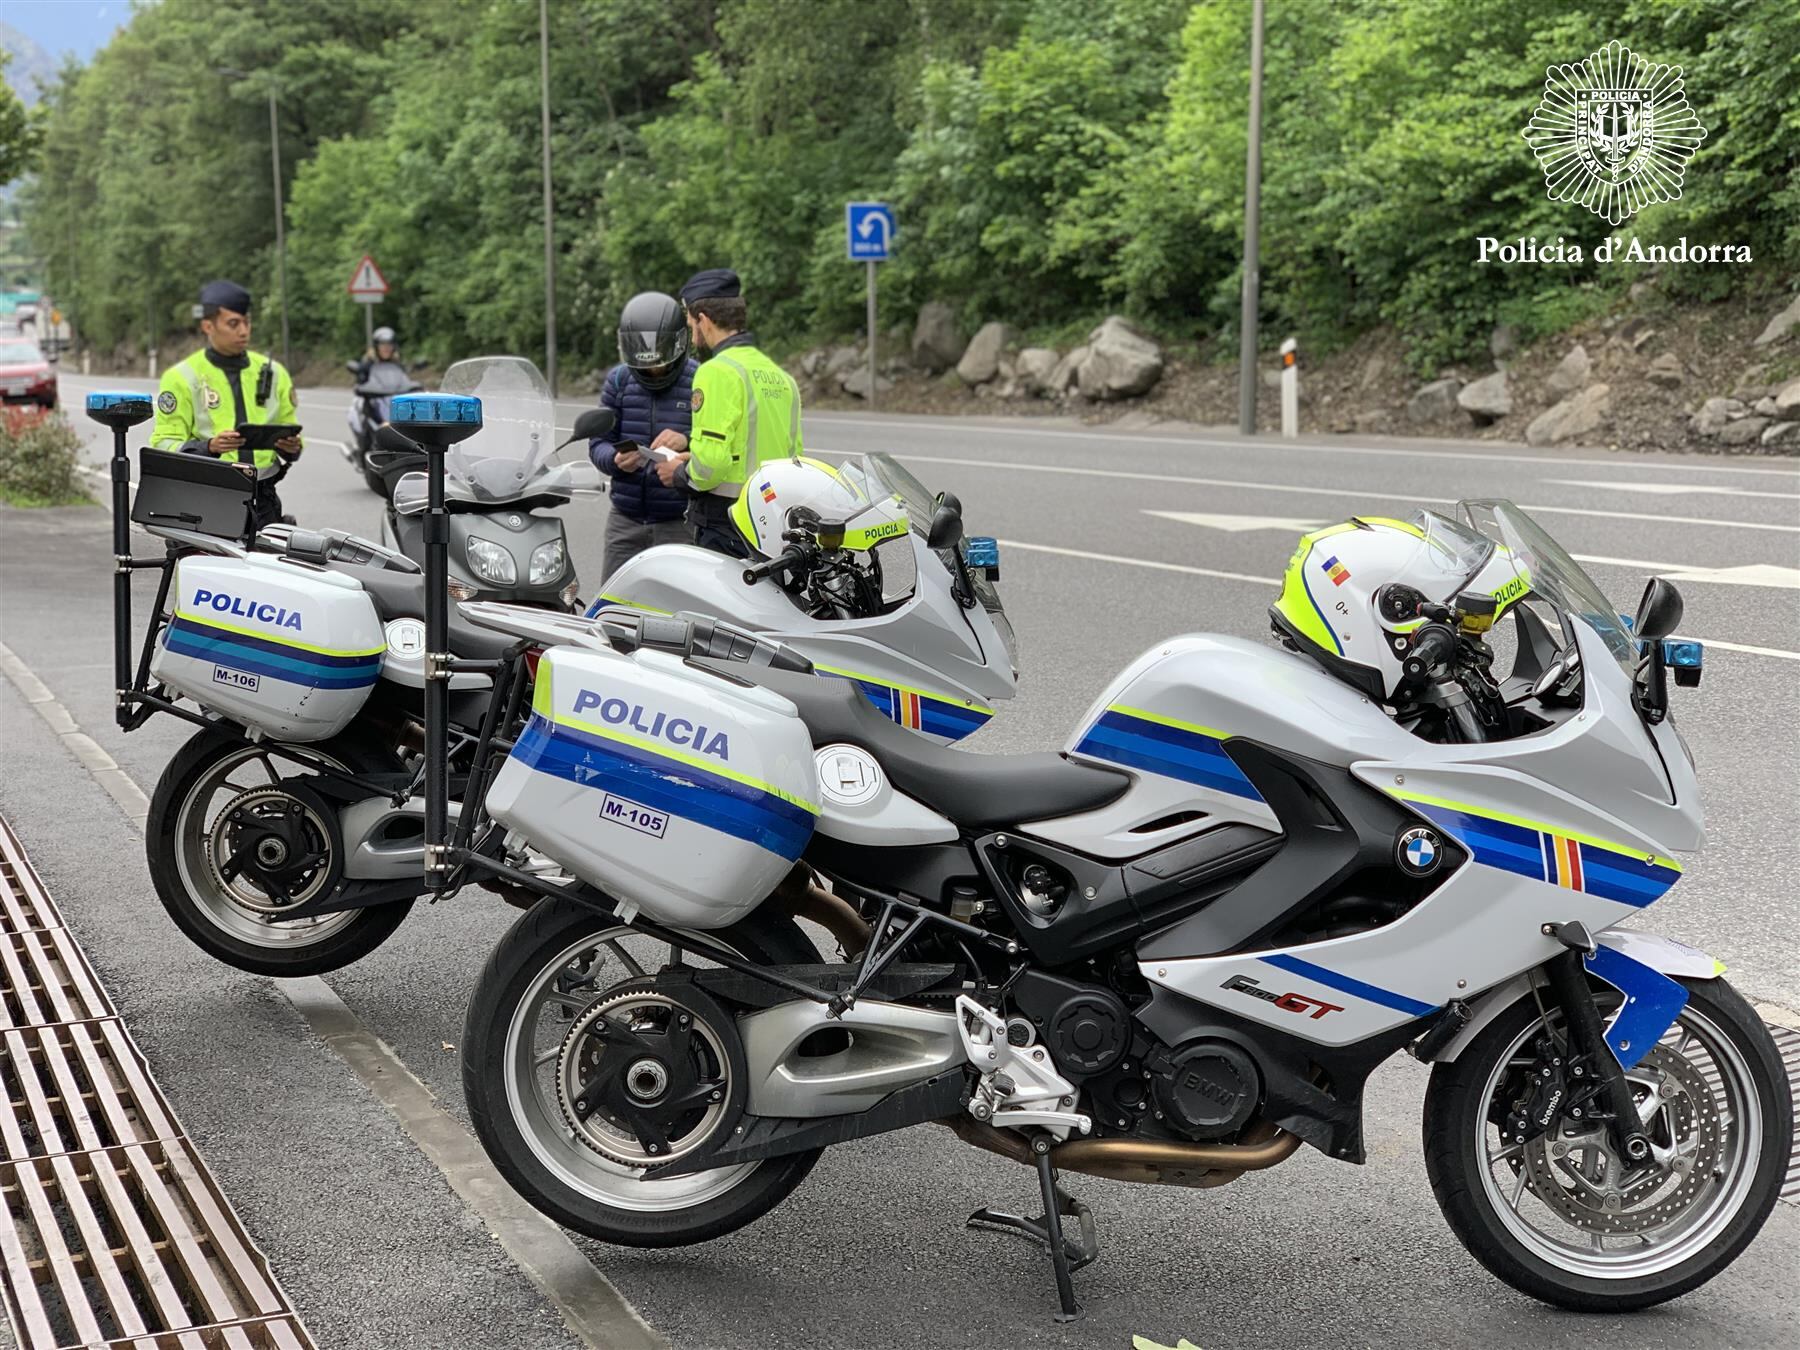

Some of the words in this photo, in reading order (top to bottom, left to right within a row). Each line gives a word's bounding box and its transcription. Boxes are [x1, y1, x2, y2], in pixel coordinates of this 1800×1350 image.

[864, 523, 899, 540] POLICIA
[1494, 579, 1523, 605] OLICIA
[193, 589, 302, 631] POLICIA
[216, 669, 256, 688] M-106
[573, 689, 729, 761] POLICIA
[605, 801, 663, 831] M-105
[1184, 1071, 1236, 1106] BMW
[1539, 1090, 1562, 1126] brembo
